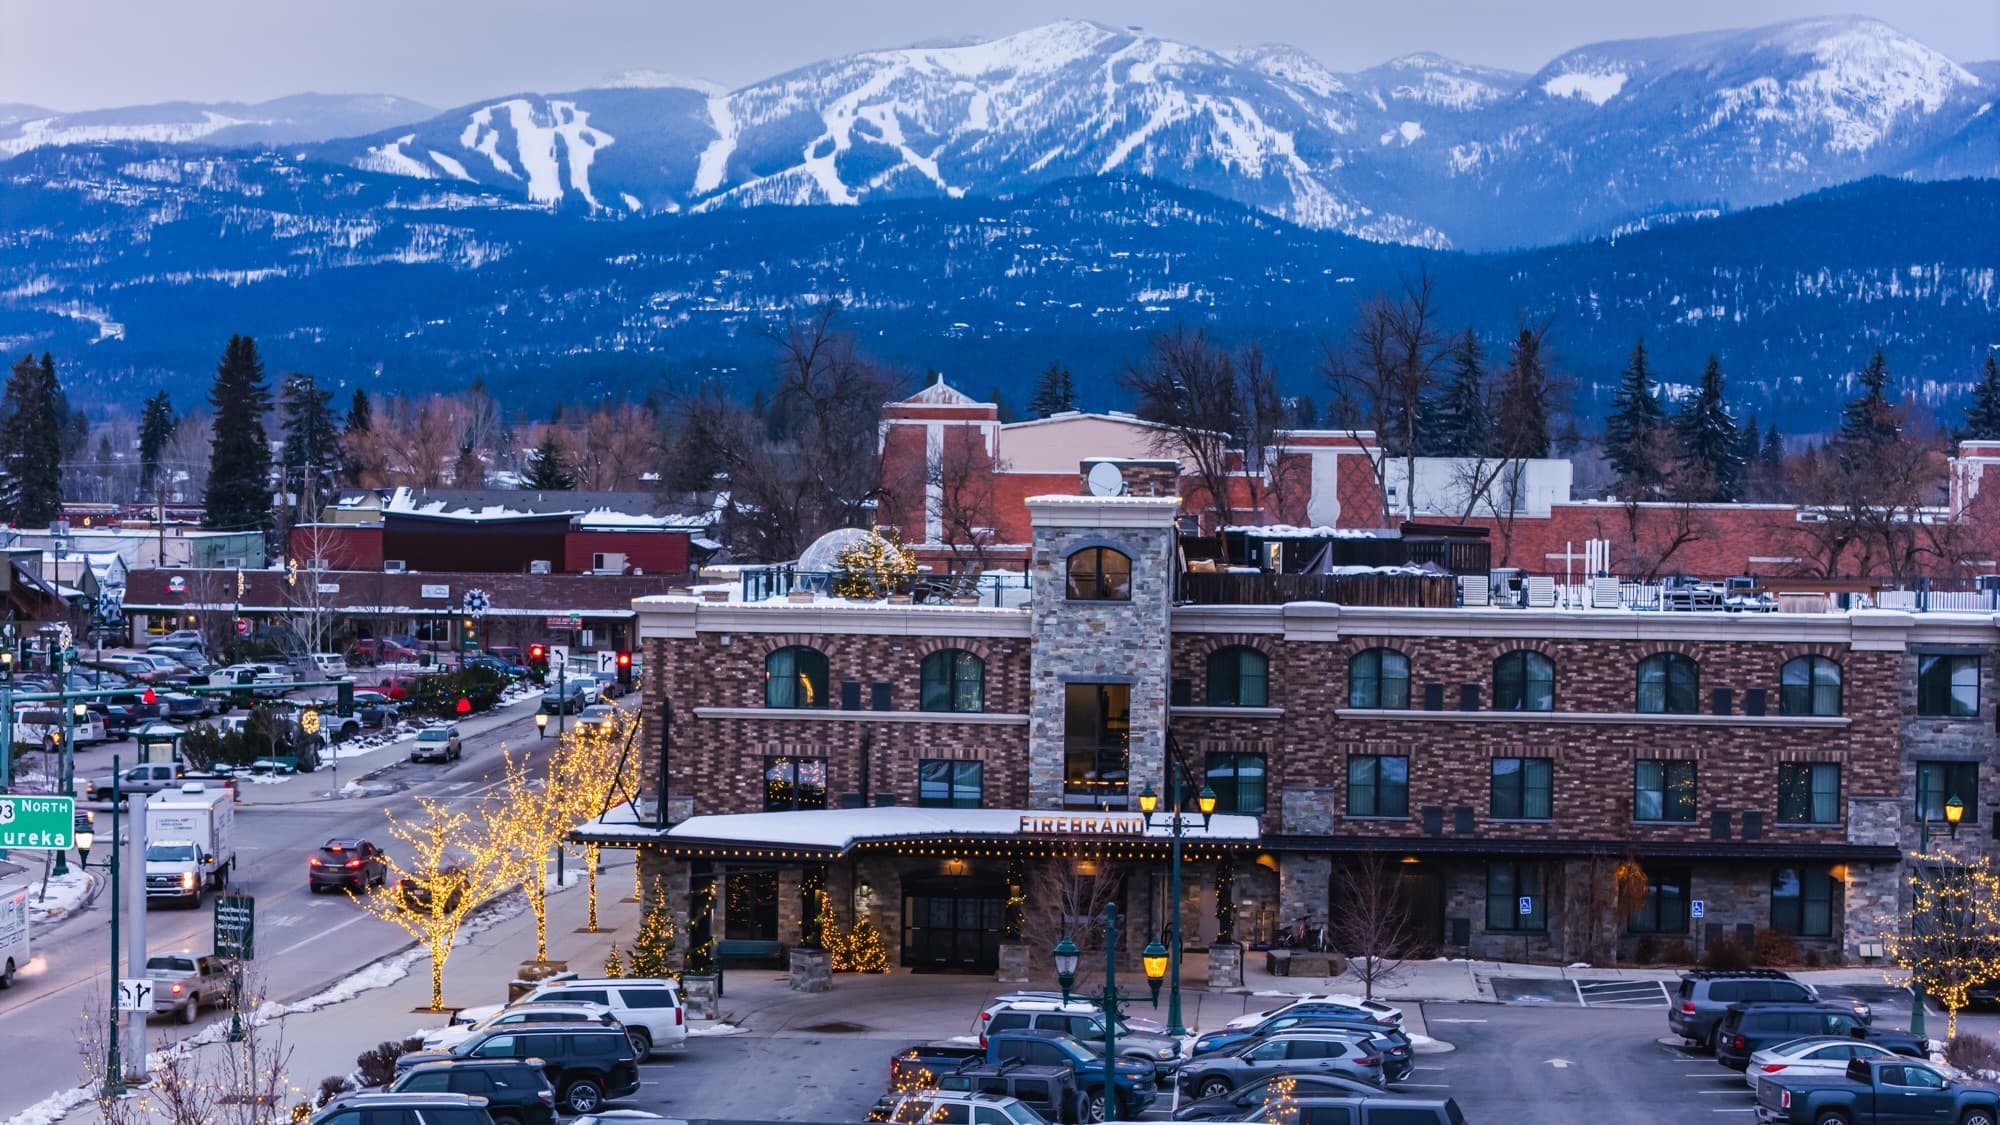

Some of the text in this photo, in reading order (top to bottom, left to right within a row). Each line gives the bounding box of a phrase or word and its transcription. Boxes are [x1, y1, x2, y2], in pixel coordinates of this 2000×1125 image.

[21, 799, 68, 813] NORTH
[1019, 815, 1144, 833] FIREBRAND
[4, 829, 65, 846] ureka
